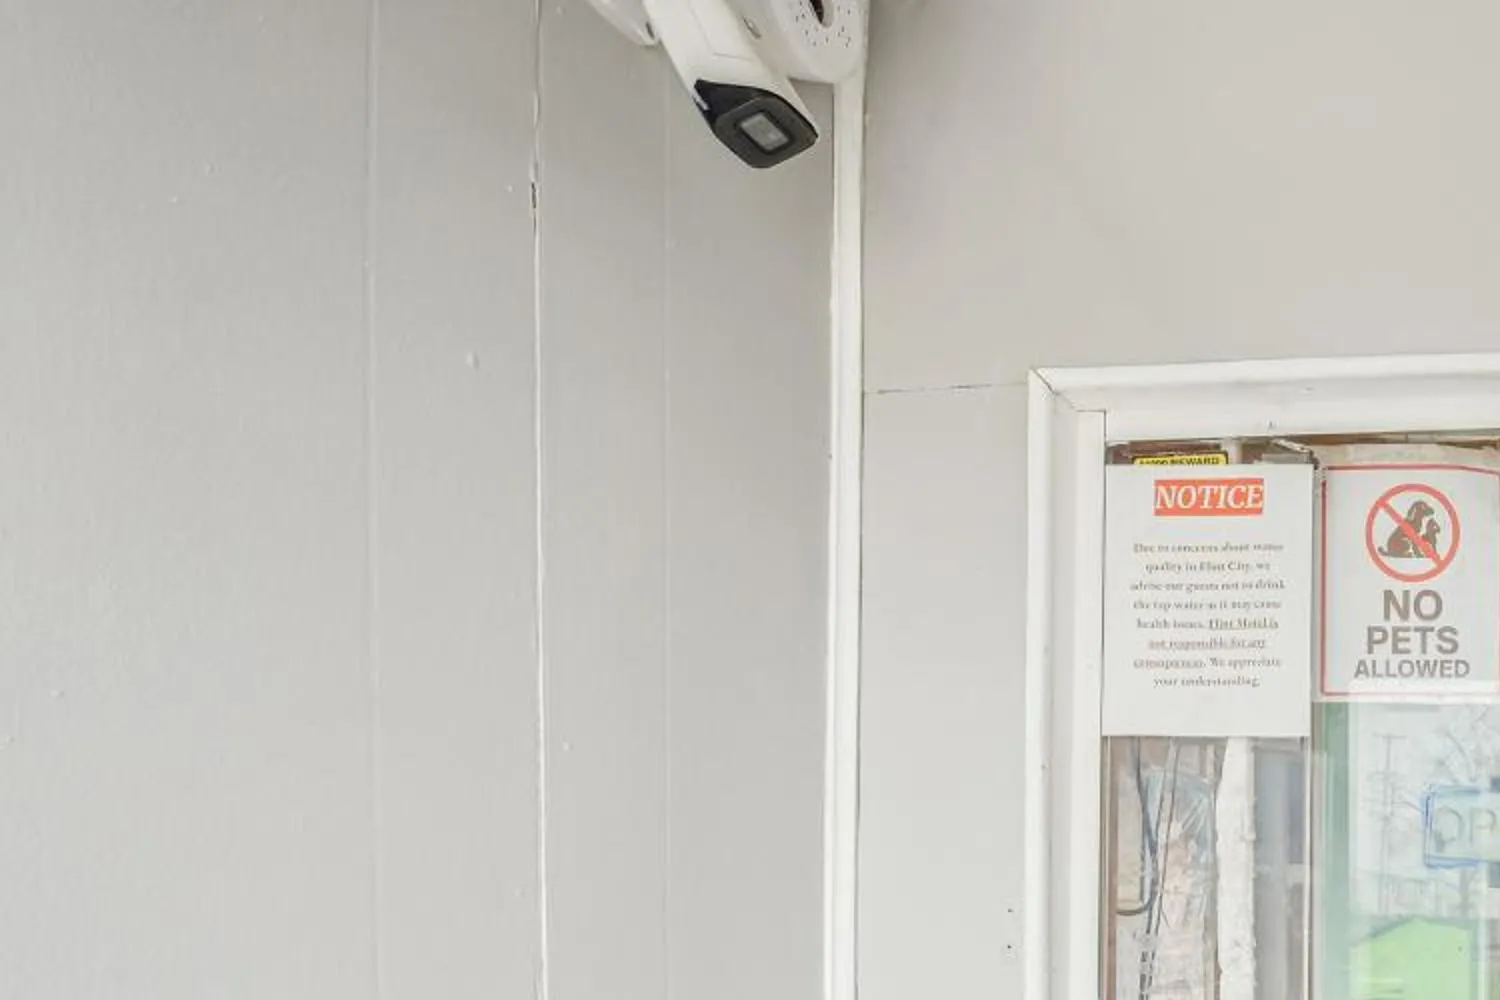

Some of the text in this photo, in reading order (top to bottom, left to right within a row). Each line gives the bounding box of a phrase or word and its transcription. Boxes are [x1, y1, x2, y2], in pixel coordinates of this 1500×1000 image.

[1154, 484, 1264, 510] NOTICE
[1383, 589, 1443, 621] NO
[1367, 626, 1459, 655] PETS
[1353, 659, 1470, 679] ALLOWED
